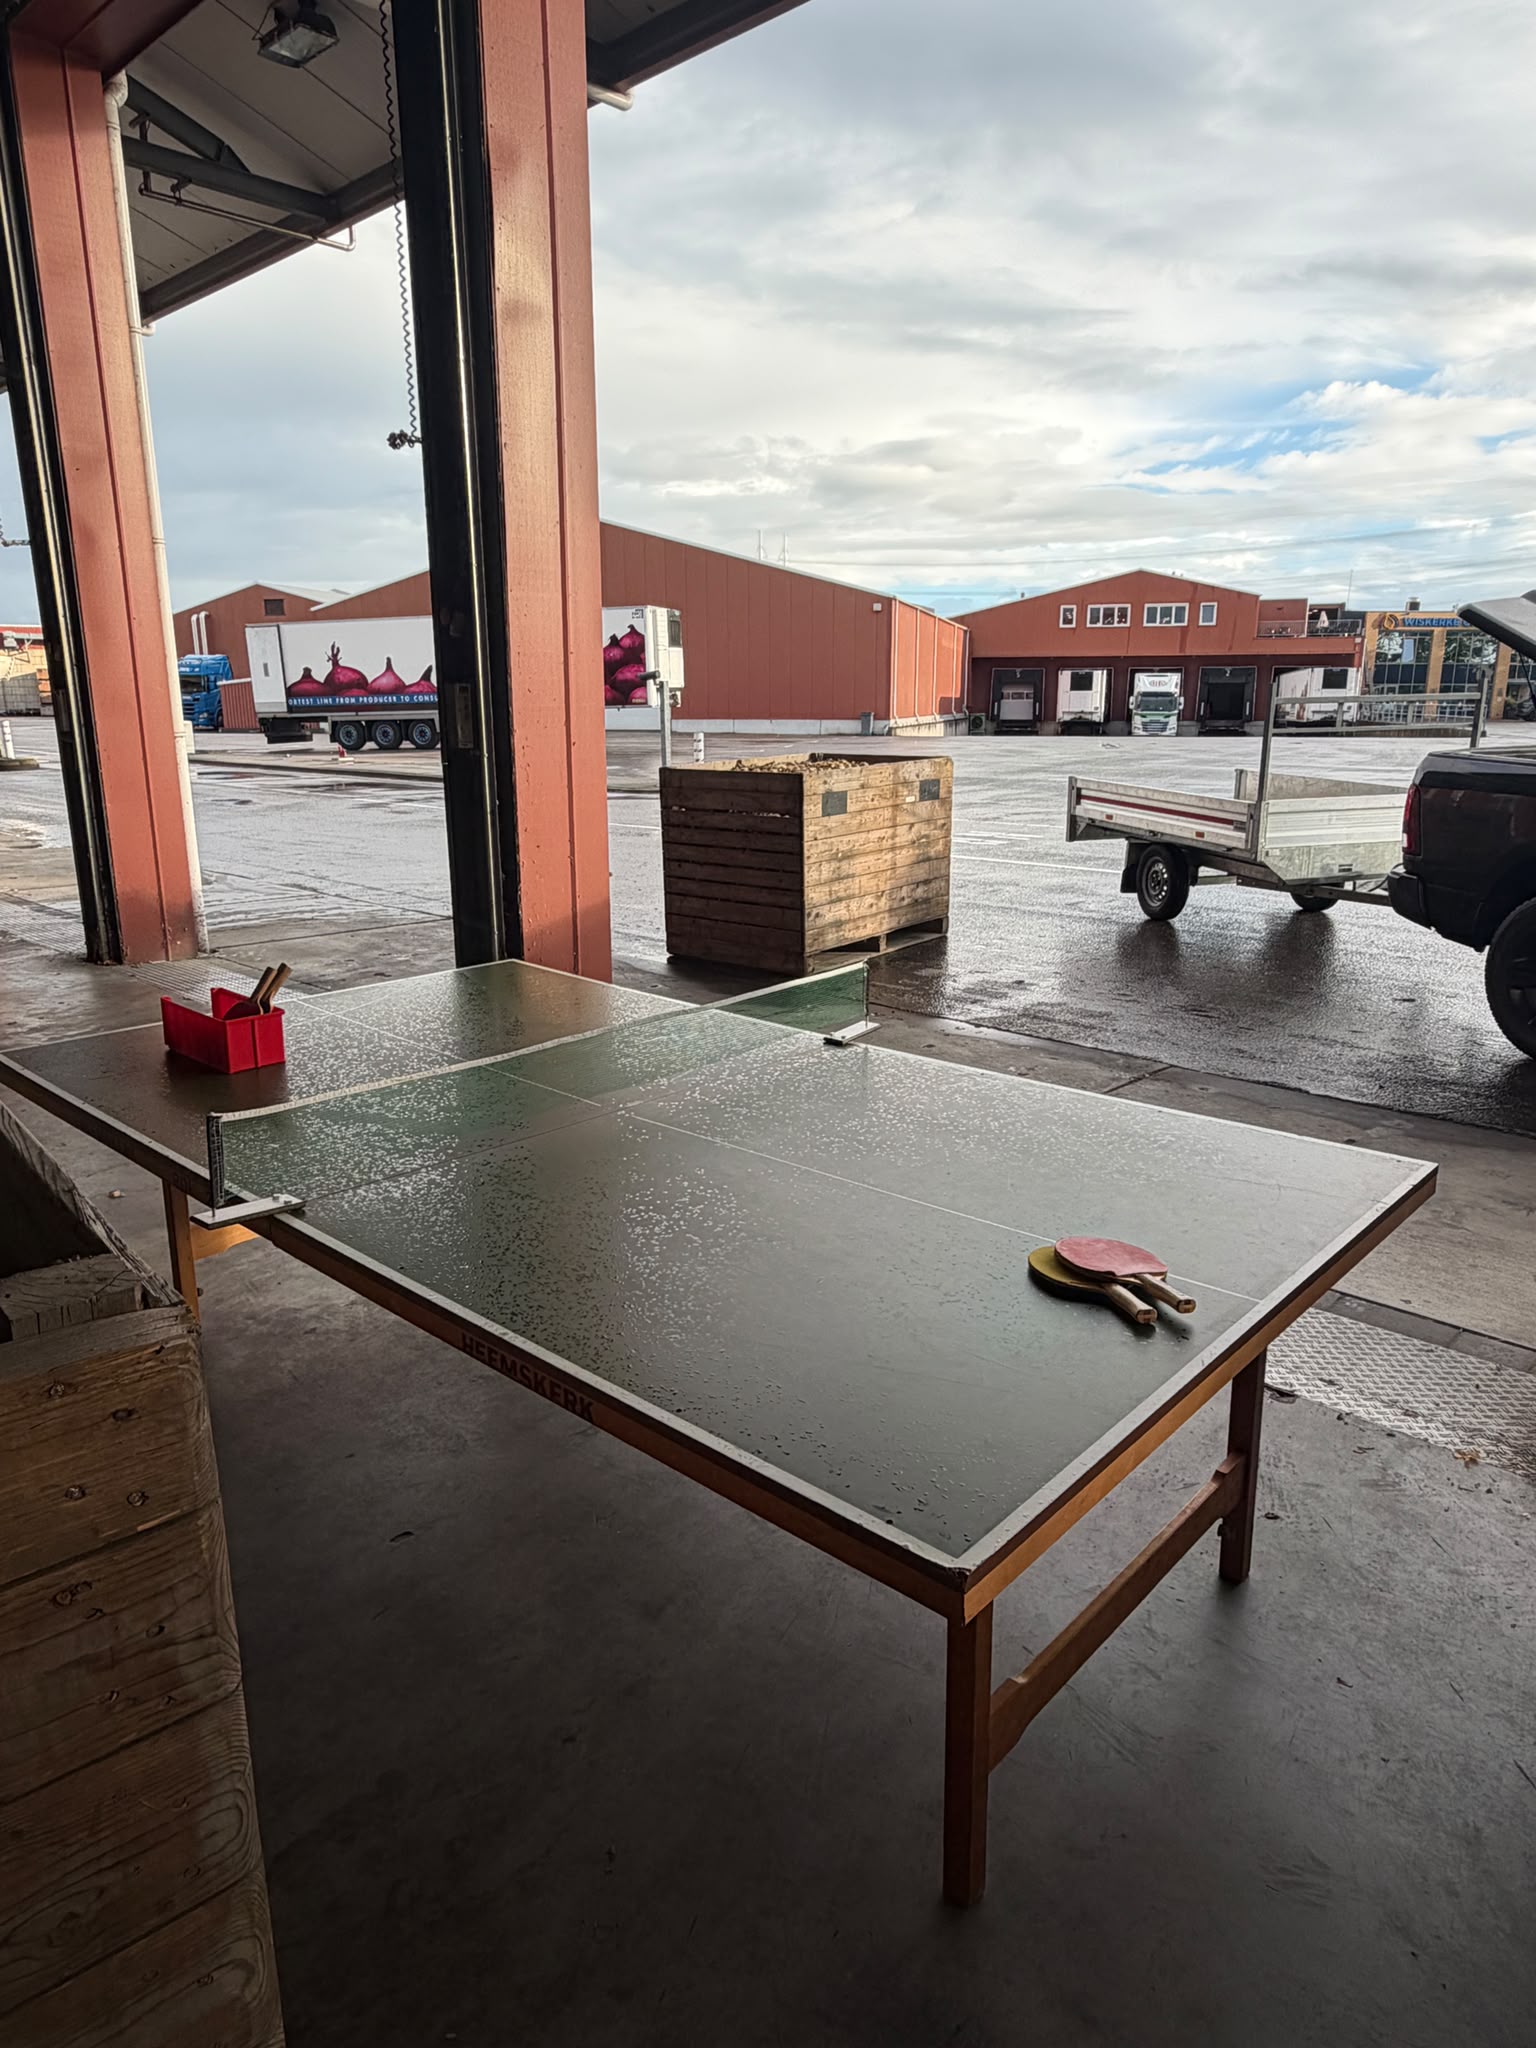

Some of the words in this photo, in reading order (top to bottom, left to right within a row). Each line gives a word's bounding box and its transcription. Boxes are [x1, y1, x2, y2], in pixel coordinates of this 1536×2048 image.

[1404, 617, 1459, 628] WISKERKE
[317, 697, 333, 705] LINE
[336, 696, 356, 704] FROM
[359, 695, 397, 704] PRODUCER
[400, 695, 410, 703] TO
[463, 1332, 593, 1424] HEEMSKERK
